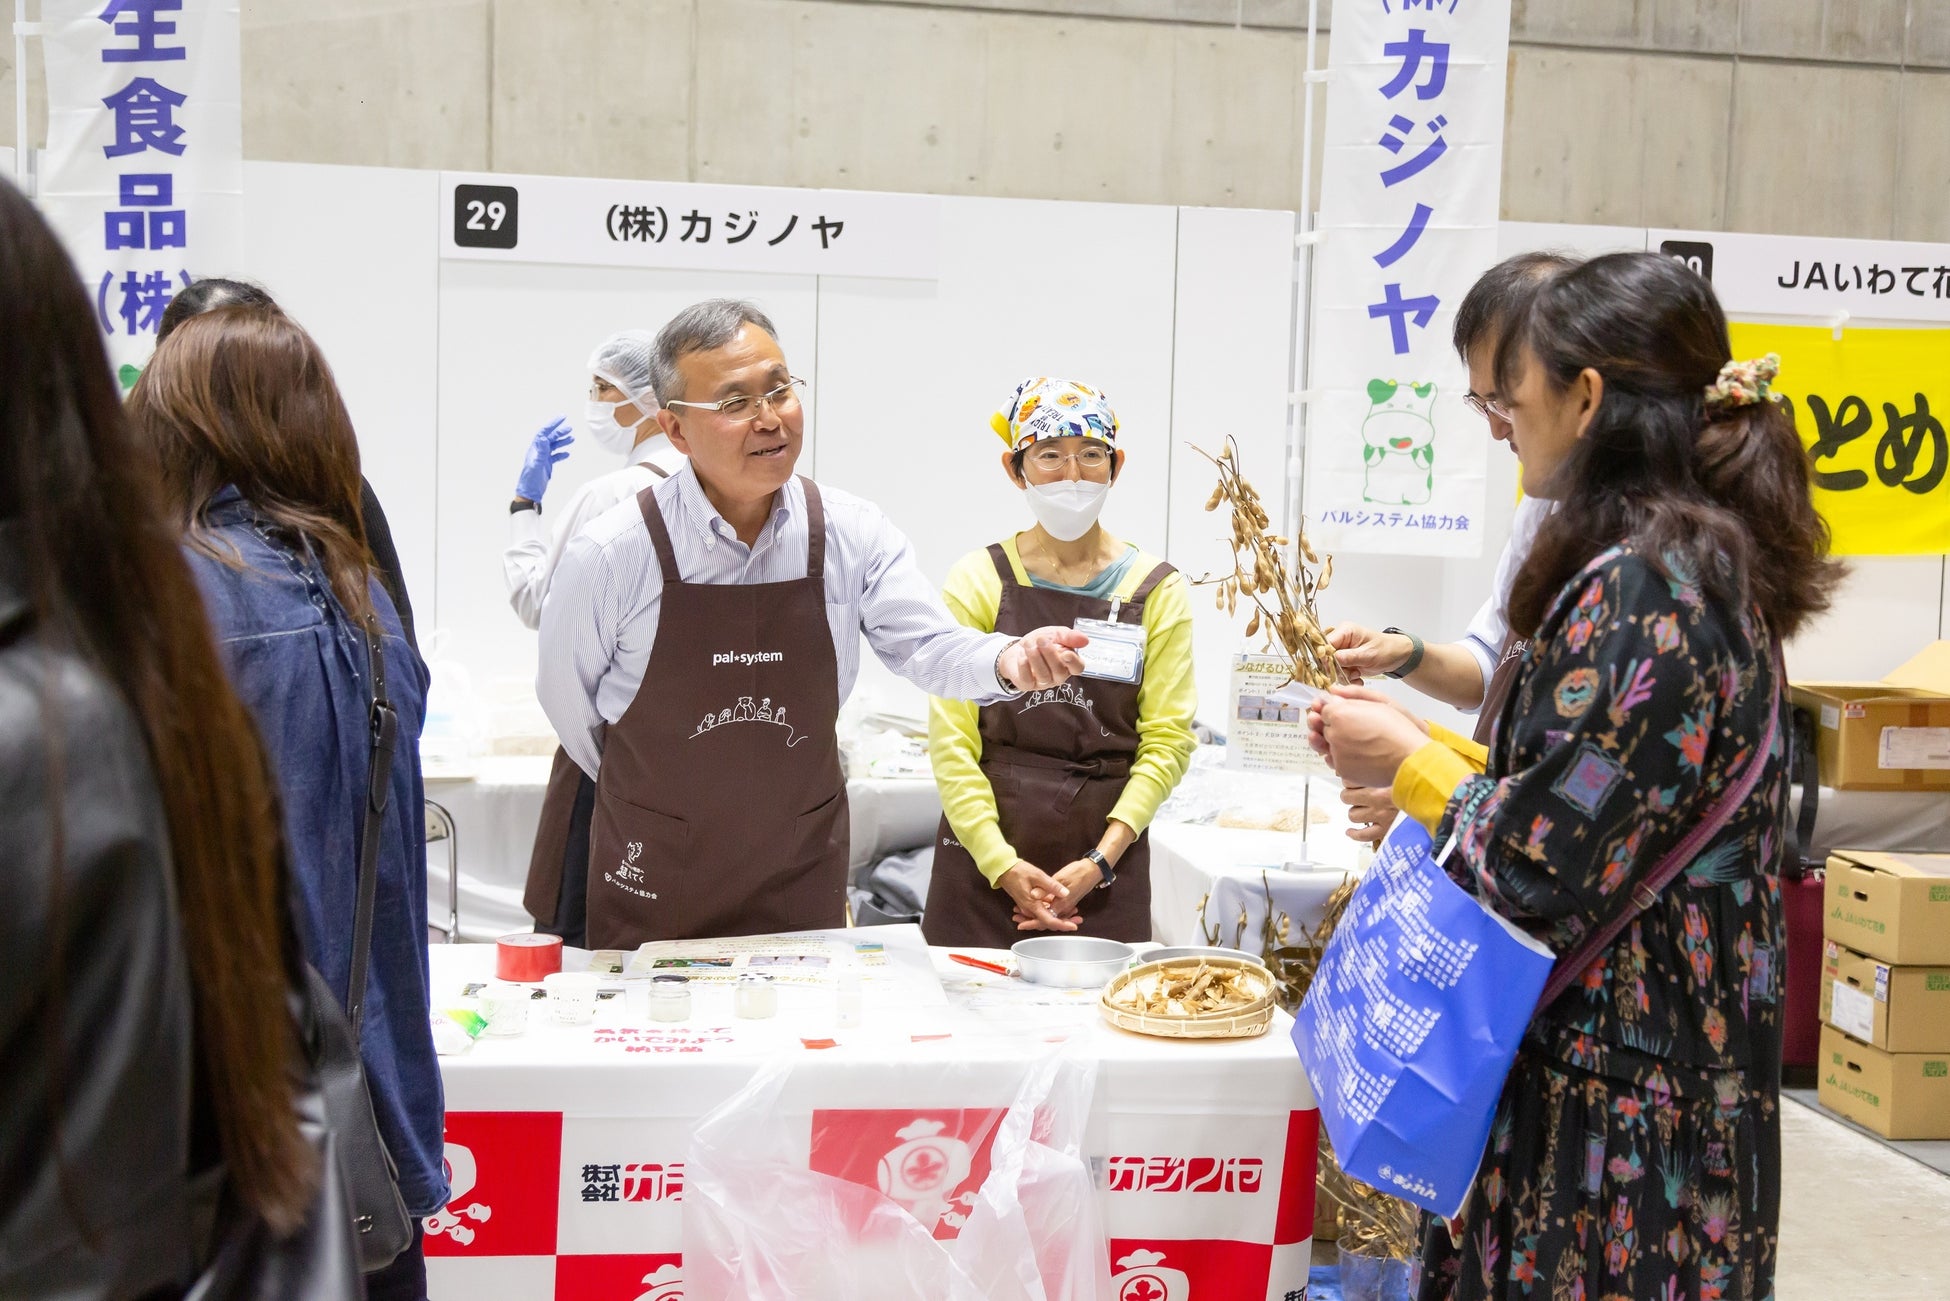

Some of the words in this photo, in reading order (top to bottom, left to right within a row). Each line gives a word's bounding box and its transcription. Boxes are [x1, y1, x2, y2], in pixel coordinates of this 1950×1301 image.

[1367, 0, 1456, 356] カジノヤ
[465, 199, 507, 232] 29
[605, 204, 844, 249] (株)カジノヤ
[1781, 392, 1949, 495] とめ
[1321, 509, 1470, 531] パルシステム協力会
[581, 1163, 621, 1183] 株式
[580, 1183, 620, 1203] 会社
